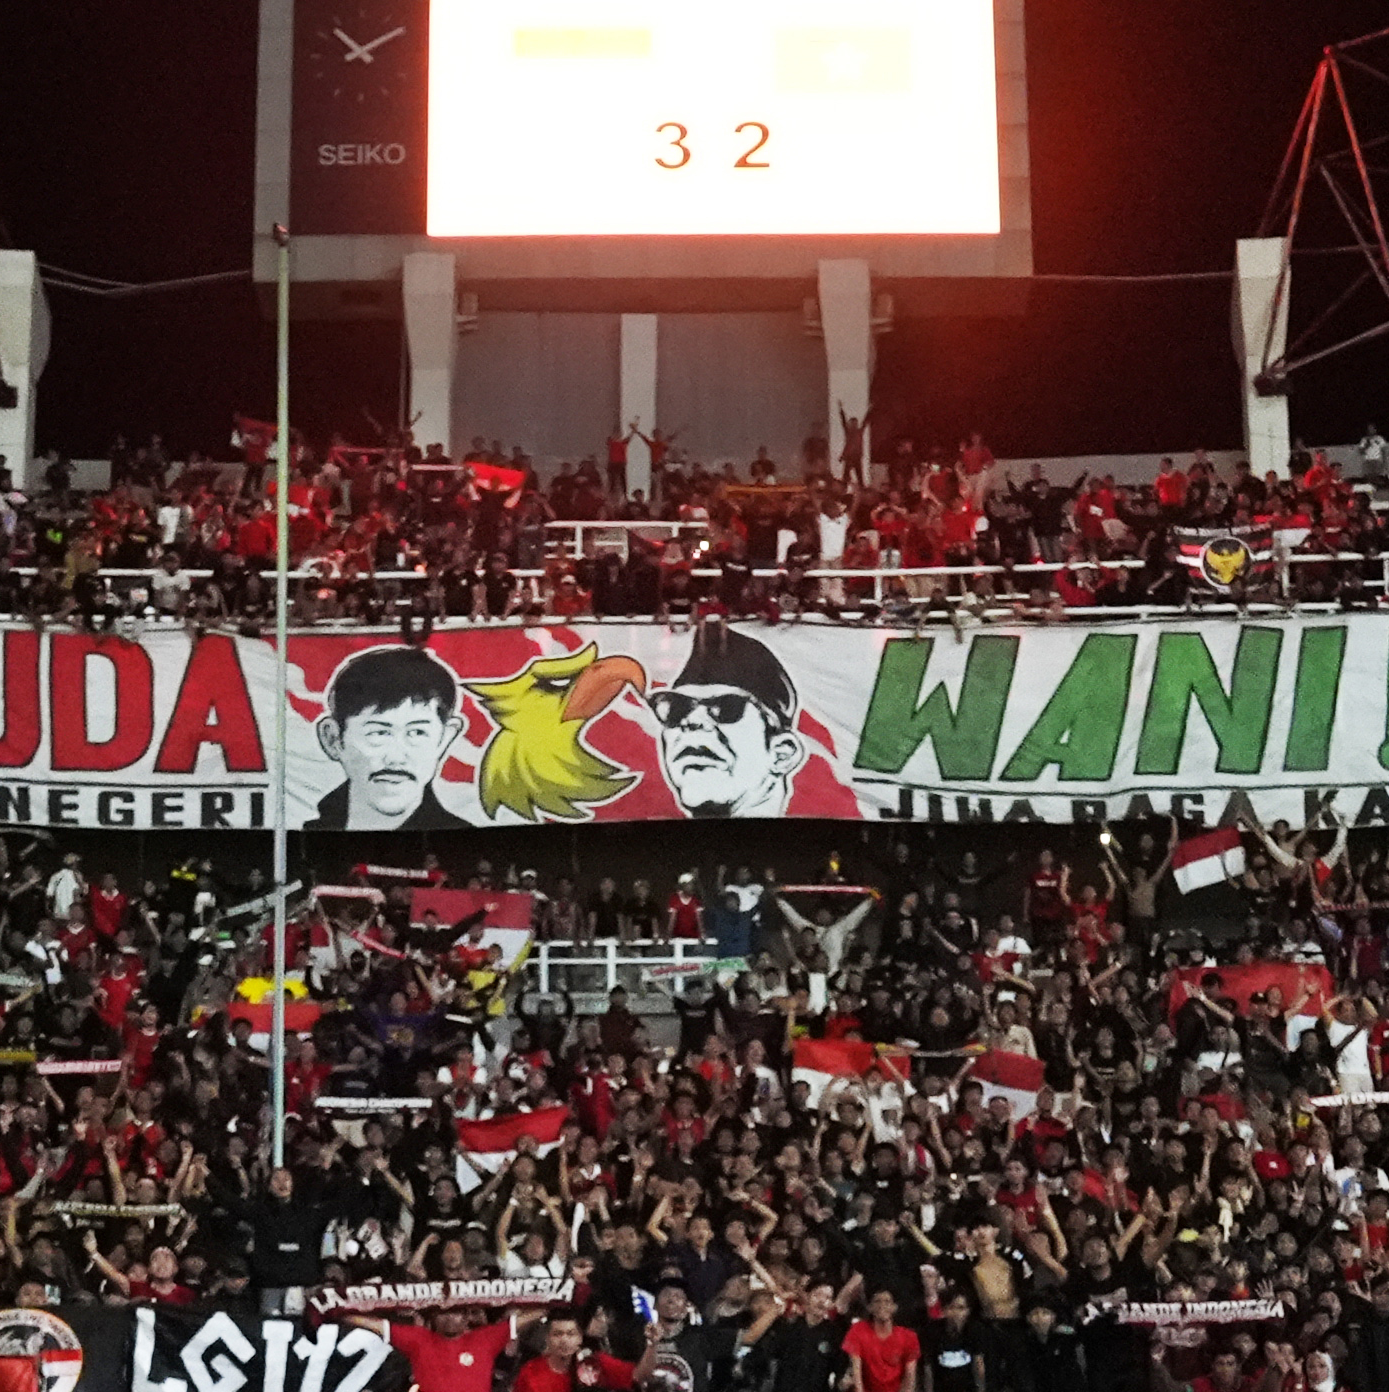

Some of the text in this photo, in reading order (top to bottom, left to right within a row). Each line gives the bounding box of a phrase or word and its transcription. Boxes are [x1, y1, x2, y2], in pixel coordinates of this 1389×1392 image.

[318, 143, 406, 167] SEIKO
[655, 121, 771, 170] 3 2
[853, 625, 1348, 781] WANI
[345, 1280, 444, 1302] GRANDE
[449, 1277, 576, 1302] INDONESIA
